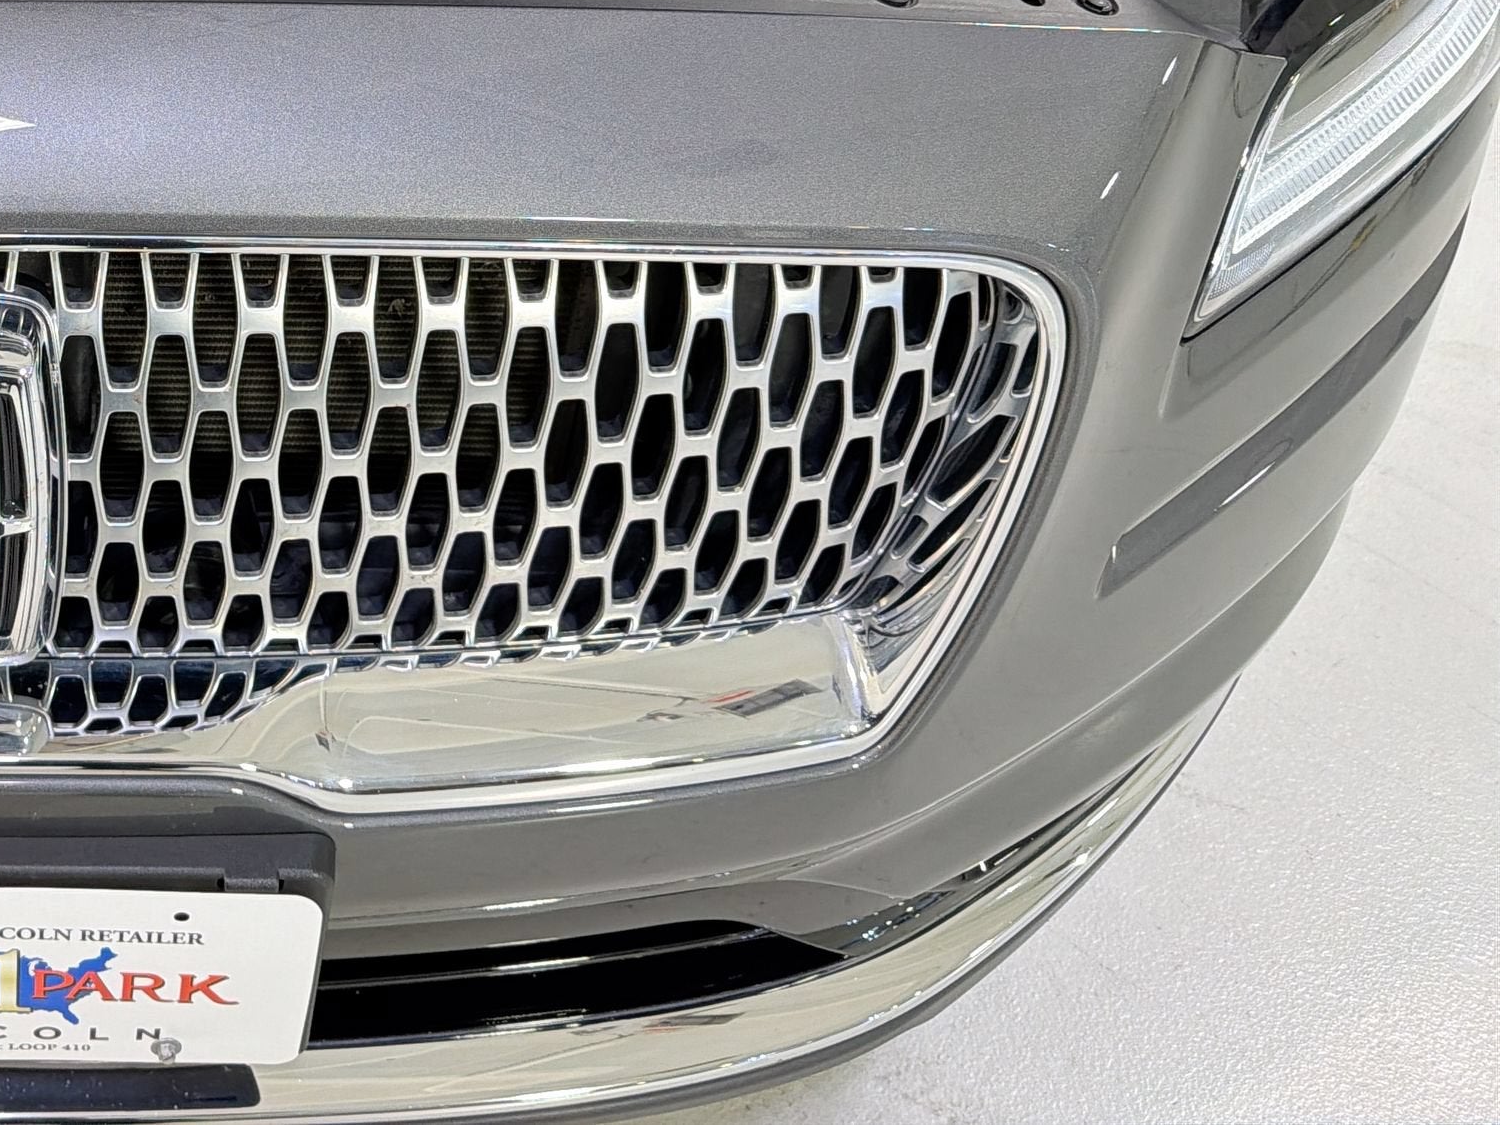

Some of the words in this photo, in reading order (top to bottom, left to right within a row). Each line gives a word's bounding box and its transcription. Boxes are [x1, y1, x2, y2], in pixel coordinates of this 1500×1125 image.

[80, 929, 205, 945] RETAILER
[32, 968, 240, 1005] PARK
[8, 1043, 57, 1051] LOOP
[61, 1043, 91, 1052] 410
